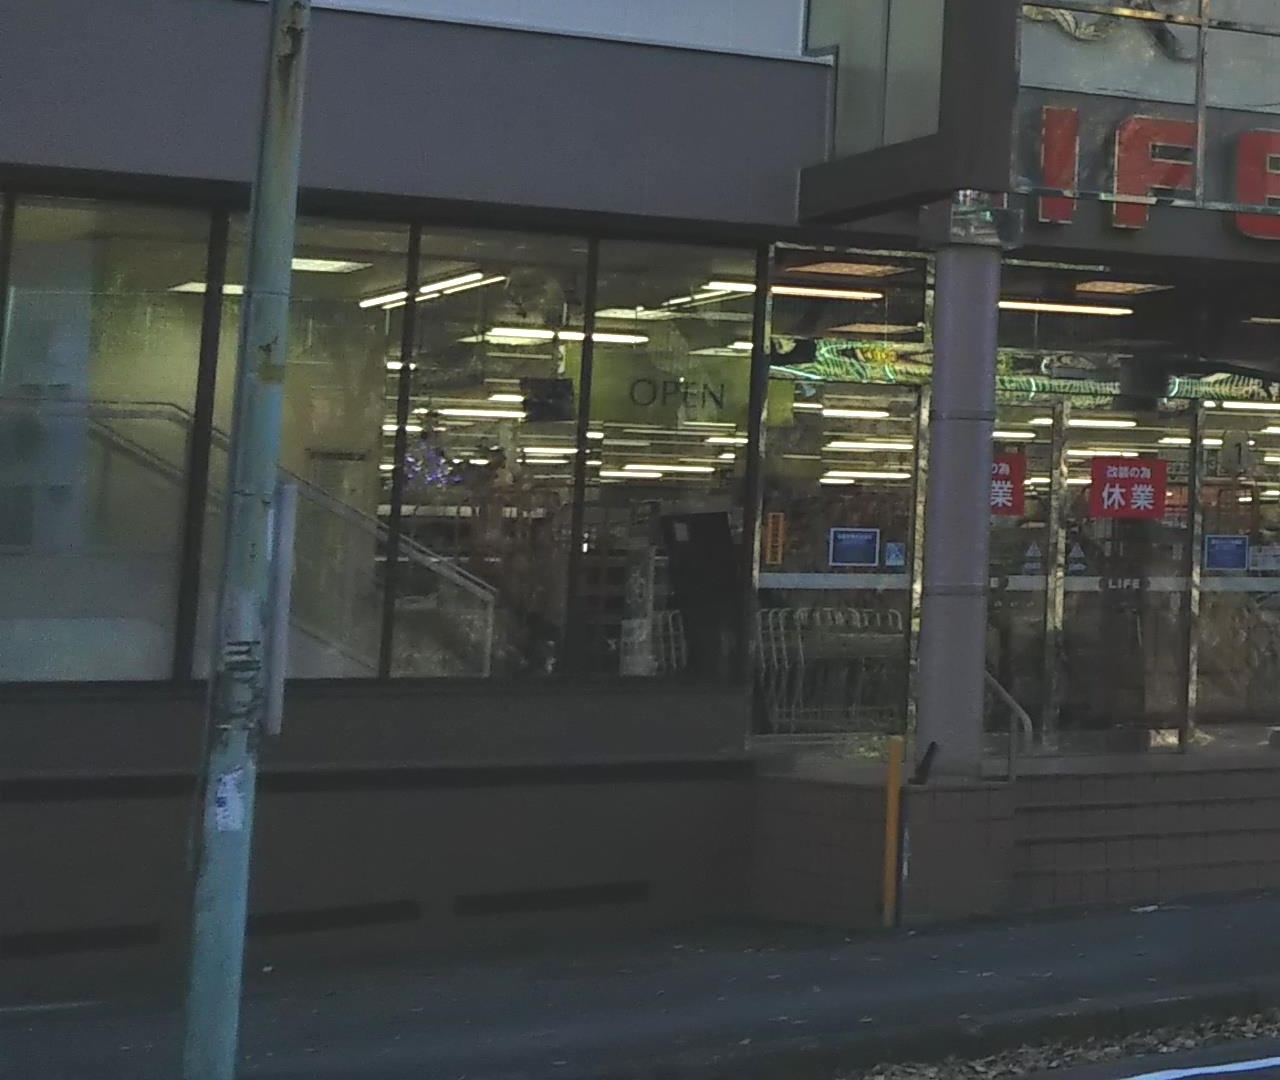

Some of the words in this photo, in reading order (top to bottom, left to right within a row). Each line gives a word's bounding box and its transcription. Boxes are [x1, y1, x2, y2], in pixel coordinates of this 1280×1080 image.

[629, 378, 725, 409] OPEN
[1101, 483, 1155, 510] 休業
[1108, 579, 1140, 589] LIFE
